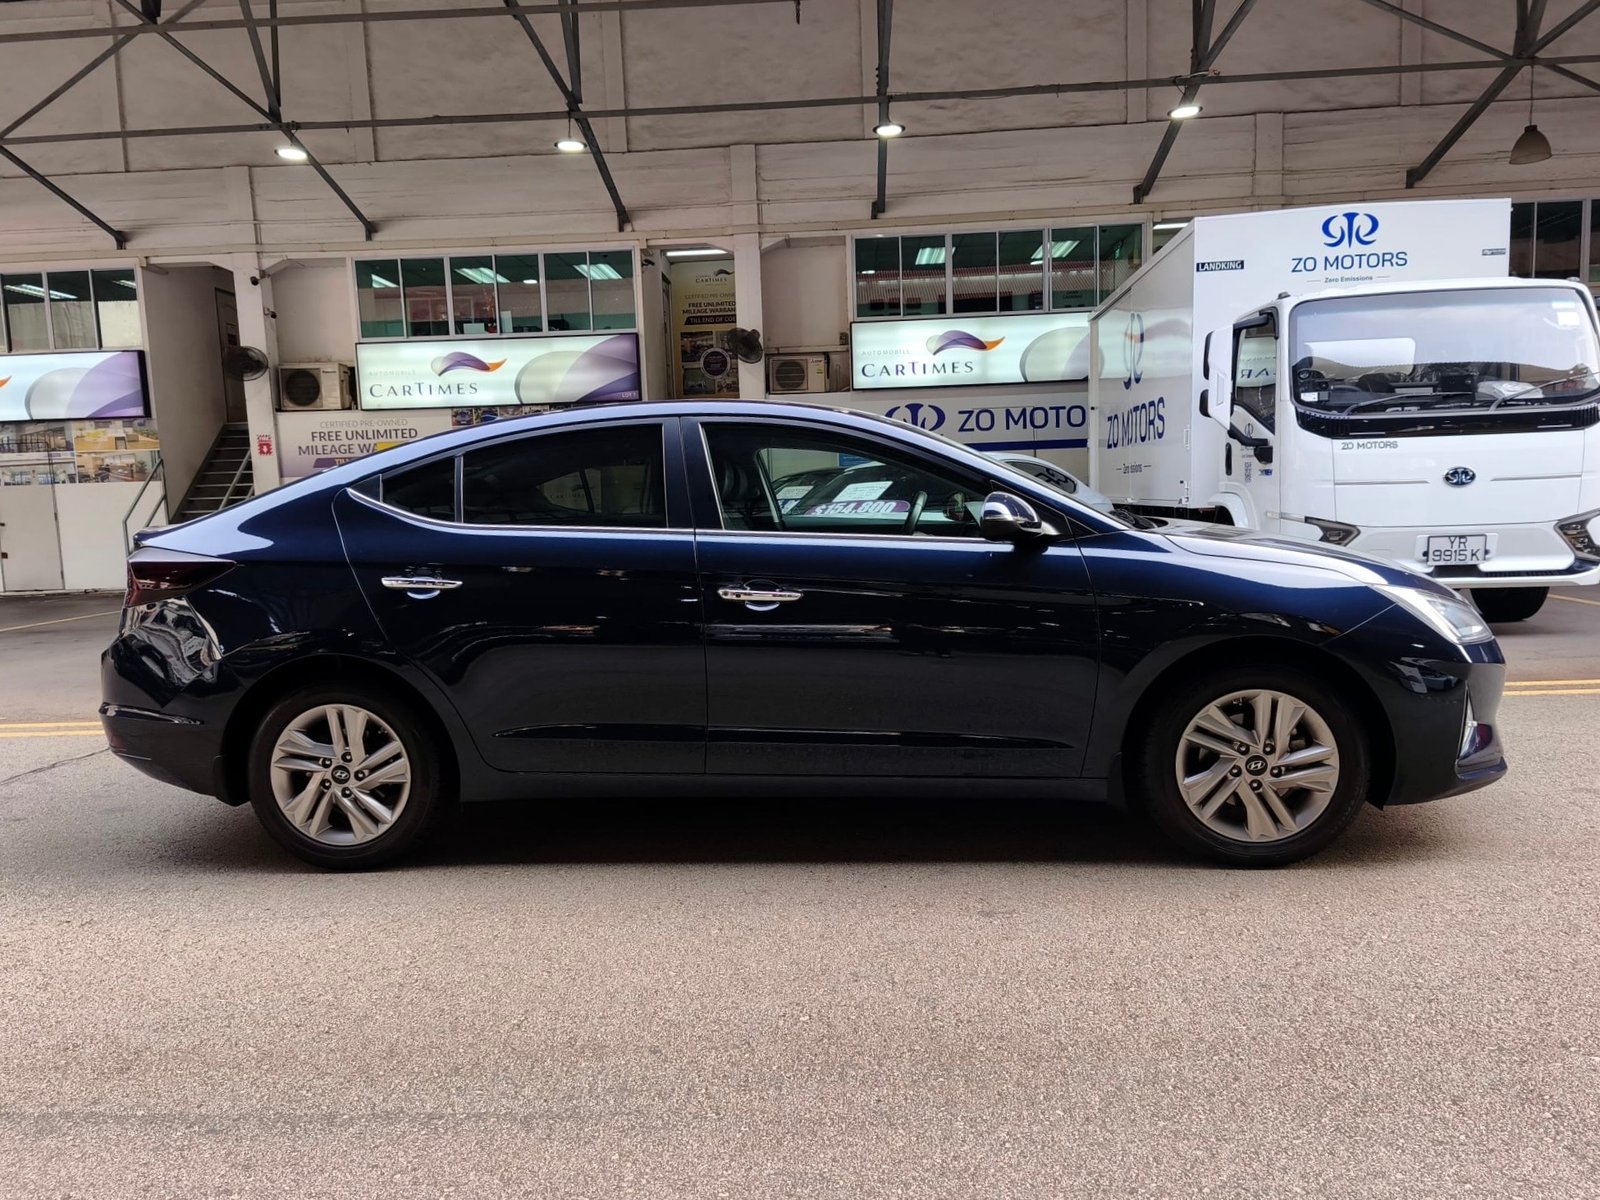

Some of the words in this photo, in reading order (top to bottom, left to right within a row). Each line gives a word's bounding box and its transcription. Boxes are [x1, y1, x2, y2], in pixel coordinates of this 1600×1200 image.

[1199, 261, 1242, 271] LANDKING
[1291, 257, 1317, 273] ZO
[1324, 251, 1408, 271] MOTORS
[1341, 275, 1373, 283] Emissions
[861, 361, 974, 378] CARTIMES
[369, 382, 478, 398] CARTIMES
[320, 420, 358, 429] CERTIFIED
[958, 409, 995, 432] ZO
[1005, 405, 1086, 430] MOTO
[311, 430, 342, 442] FREE
[345, 428, 418, 441] UNLIMITED
[1107, 413, 1119, 449] ZO
[298, 443, 355, 456] MILEAGE
[1341, 441, 1354, 450] ZO
[1357, 440, 1399, 450] MOTORS
[1448, 536, 1468, 549] YR
